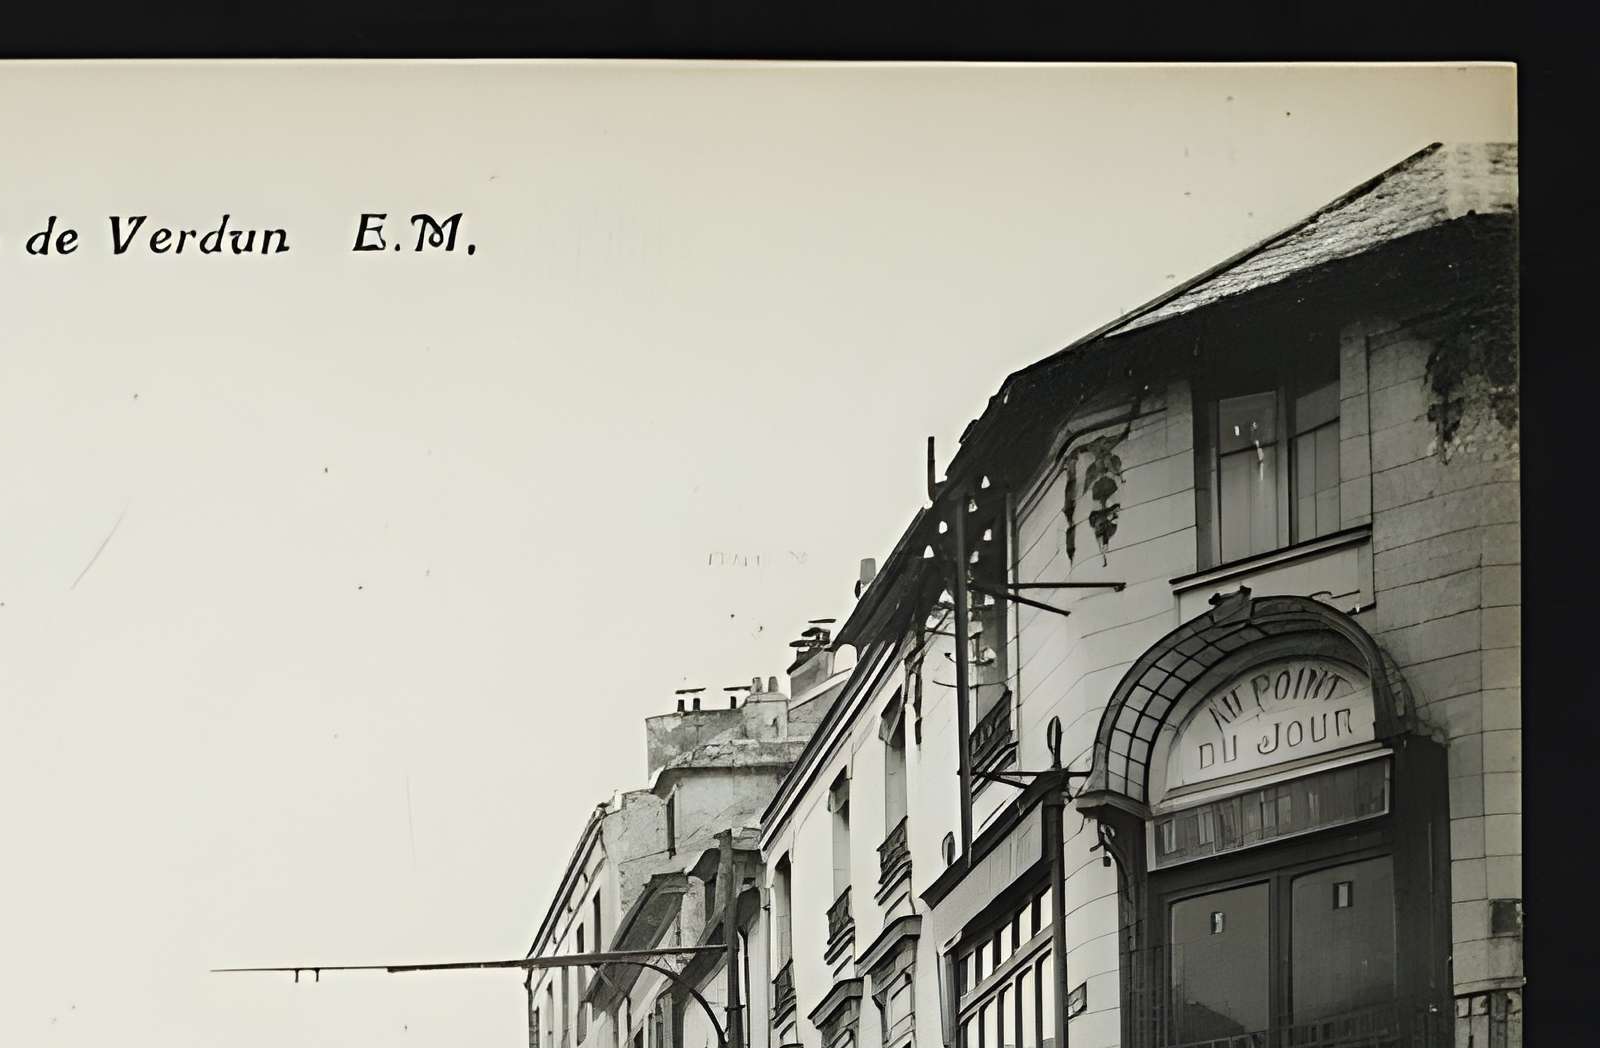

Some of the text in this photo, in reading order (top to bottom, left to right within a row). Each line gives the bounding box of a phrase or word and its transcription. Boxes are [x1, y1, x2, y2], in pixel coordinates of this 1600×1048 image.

[1250, 665, 1352, 713] POINT
[1198, 707, 1353, 770] DU JOUR
